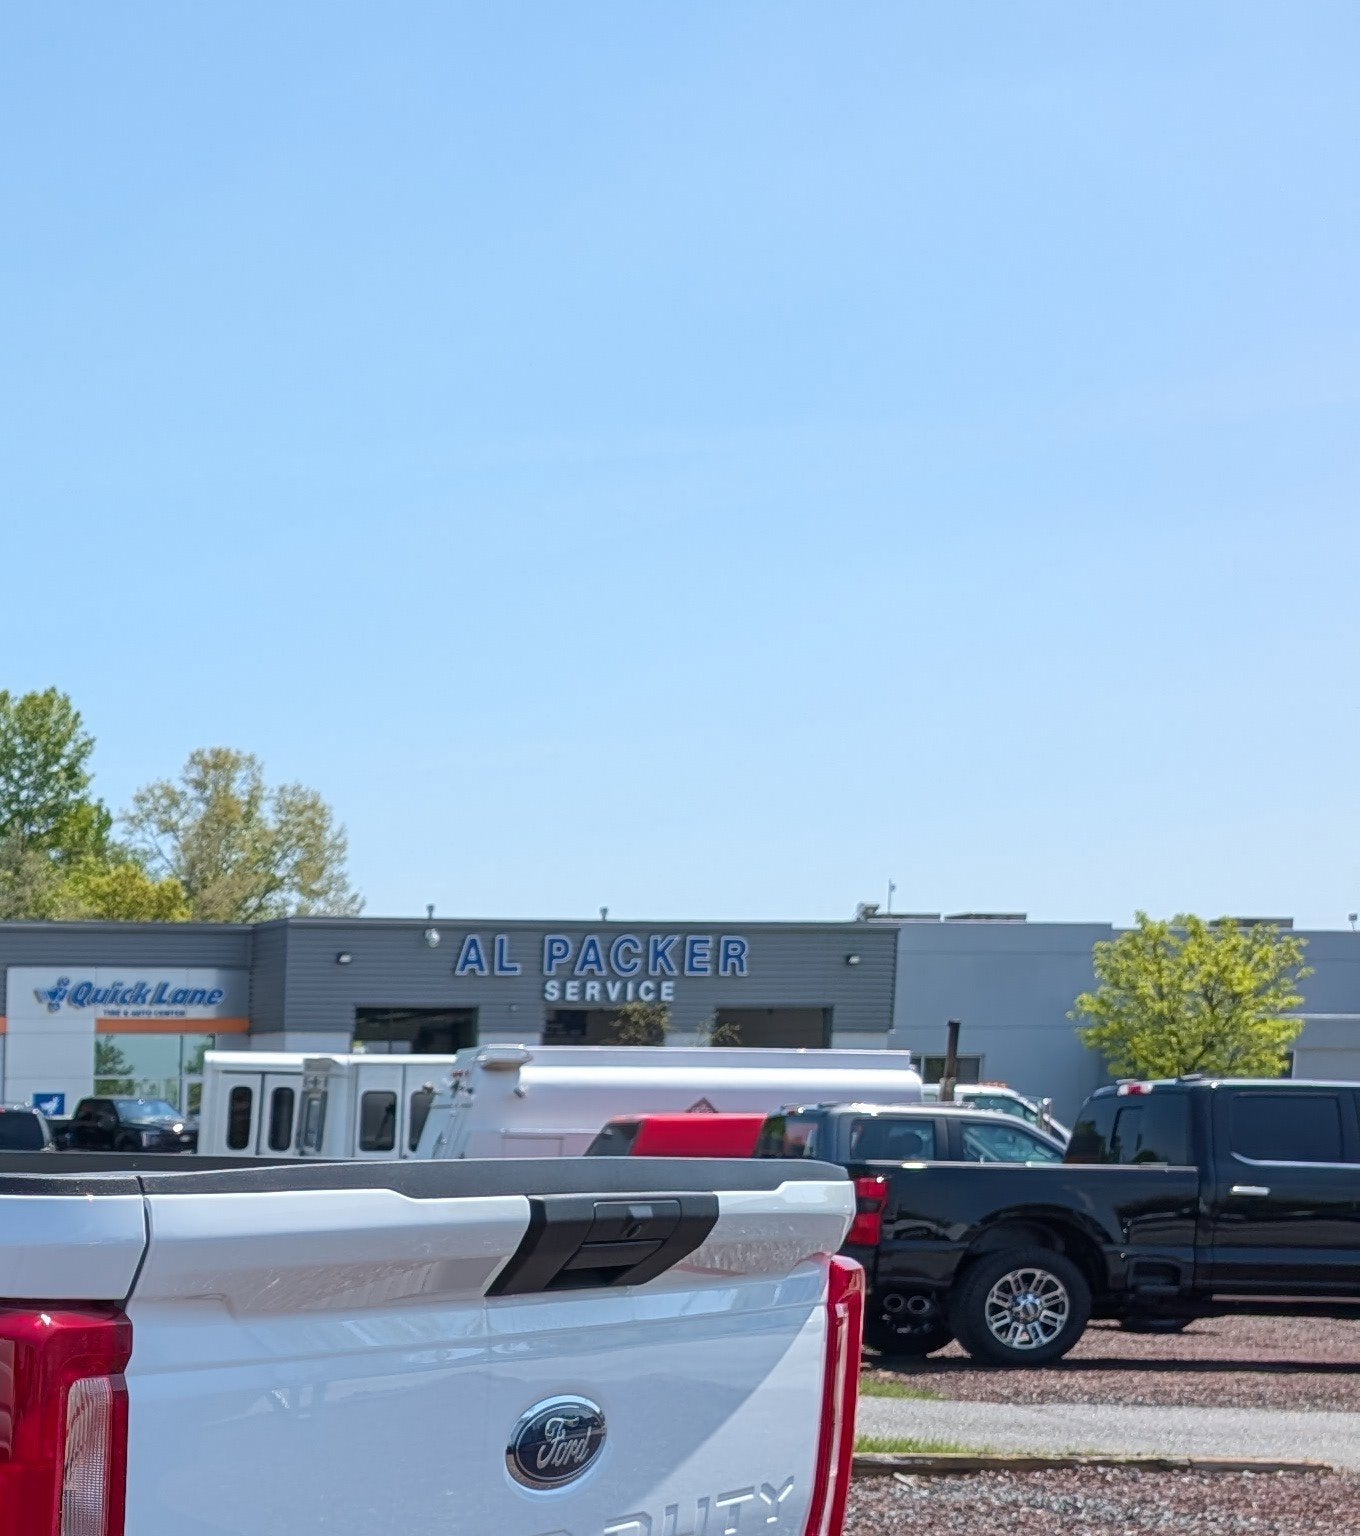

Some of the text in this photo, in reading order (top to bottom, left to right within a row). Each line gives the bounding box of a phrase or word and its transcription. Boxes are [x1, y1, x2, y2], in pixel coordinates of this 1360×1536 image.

[455, 934, 749, 977] AL PACKER
[544, 979, 675, 1001] SERVICE
[536, 1416, 591, 1470] Ford
